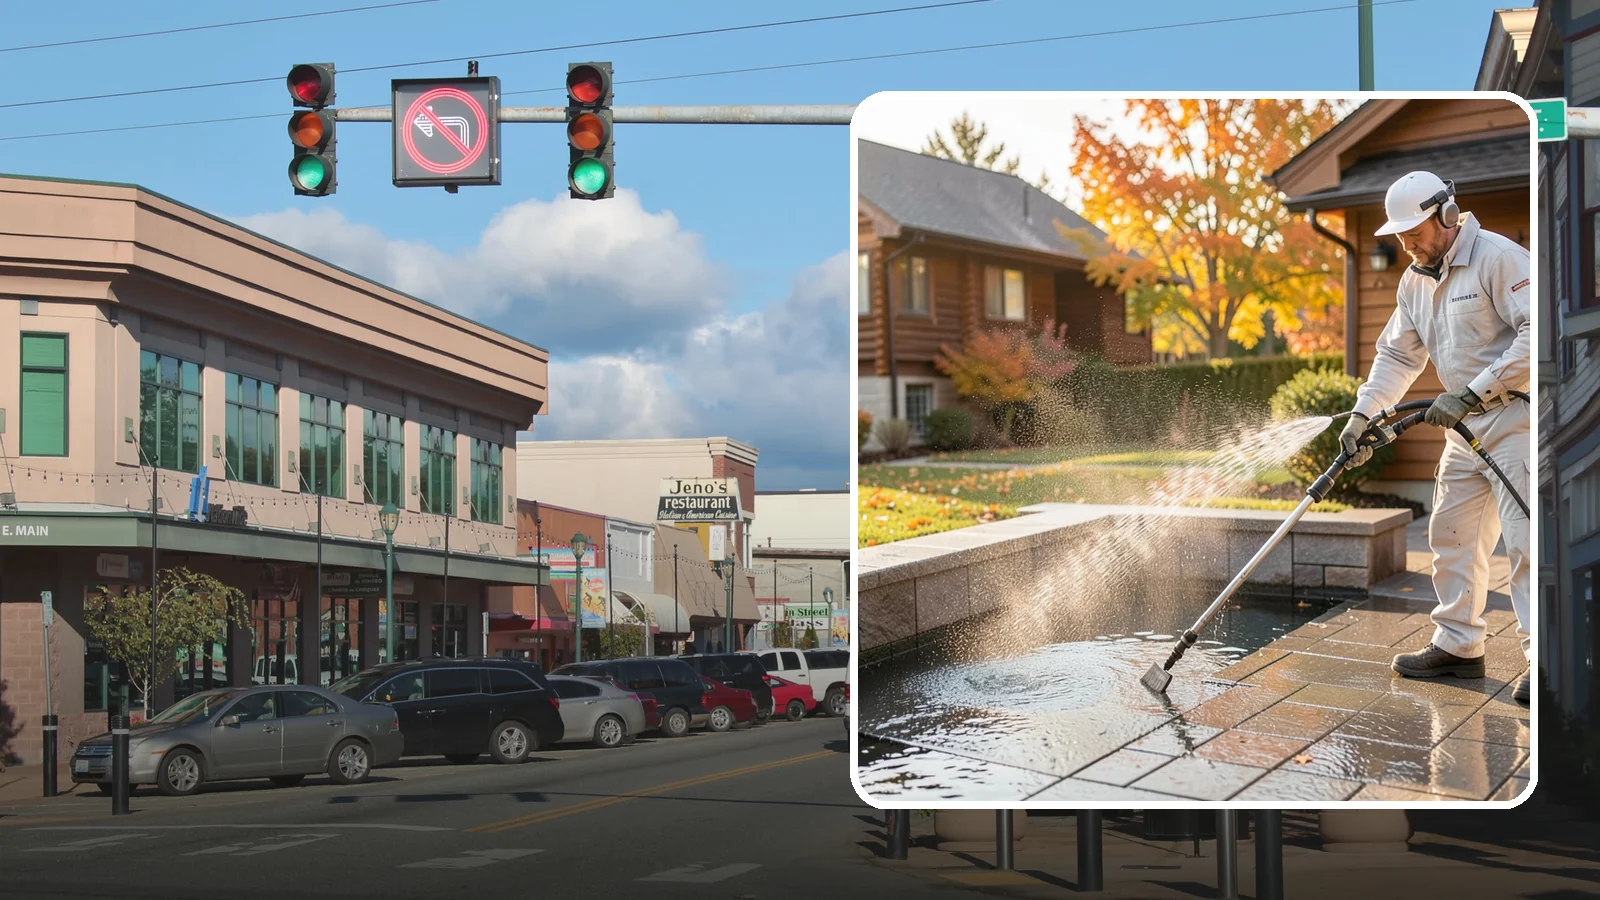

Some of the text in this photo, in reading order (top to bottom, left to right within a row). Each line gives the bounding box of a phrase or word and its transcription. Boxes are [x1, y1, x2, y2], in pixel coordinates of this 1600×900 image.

[669, 480, 727, 494] Jeno's
[665, 496, 731, 509] restaurant
[659, 510, 682, 520] Italian
[686, 510, 714, 519] American
[715, 510, 737, 519] Cuisine
[2, 525, 49, 536] E. MAIN
[797, 607, 828, 617] Street
[791, 619, 823, 627] lass
